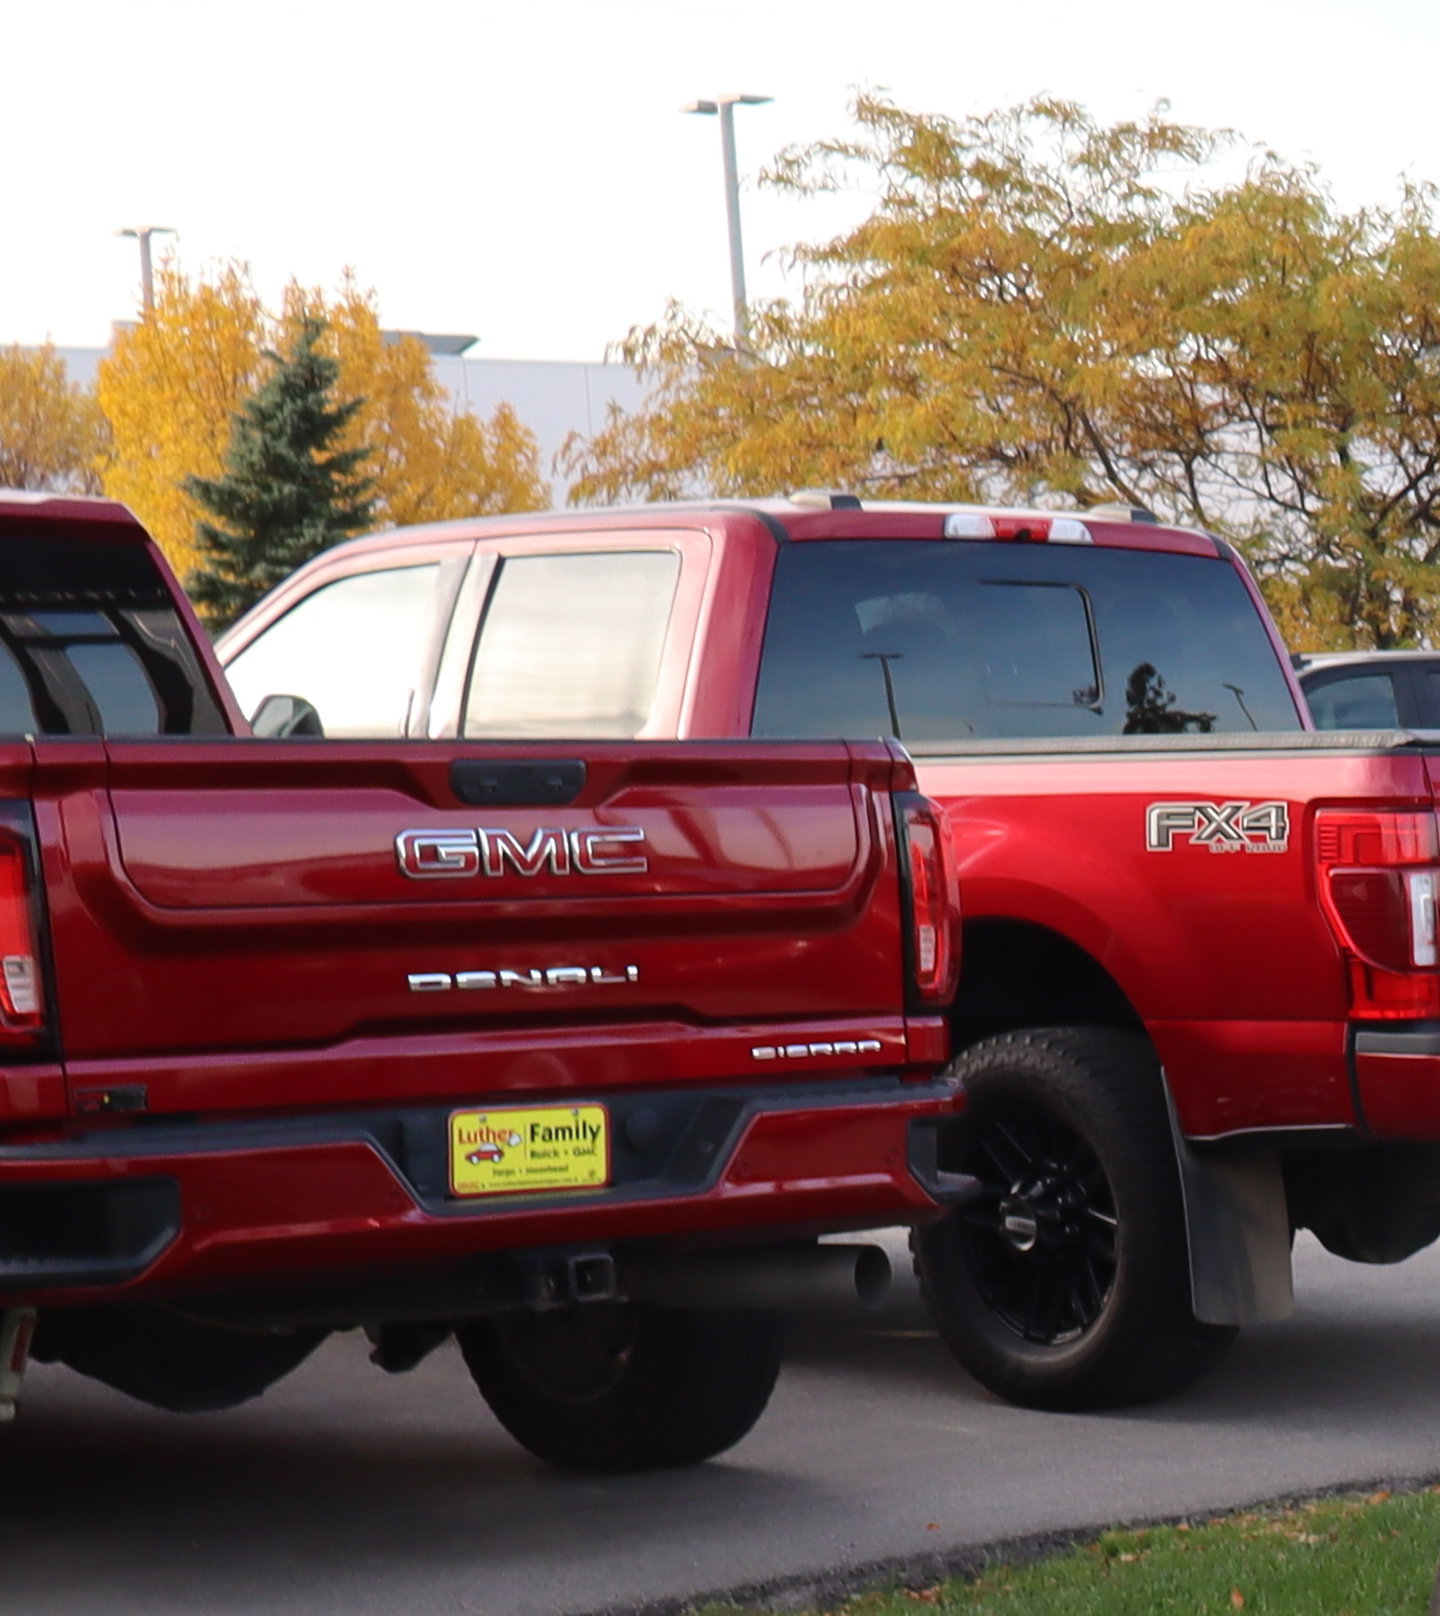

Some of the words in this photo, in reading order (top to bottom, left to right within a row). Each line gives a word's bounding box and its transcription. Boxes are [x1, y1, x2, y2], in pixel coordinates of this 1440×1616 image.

[1146, 801, 1290, 851] FX4
[395, 827, 647, 879] GMC
[407, 964, 639, 991] DENALI
[751, 1040, 881, 1060] SIERRA
[458, 1125, 515, 1144] Luther
[530, 1119, 601, 1144] Family
